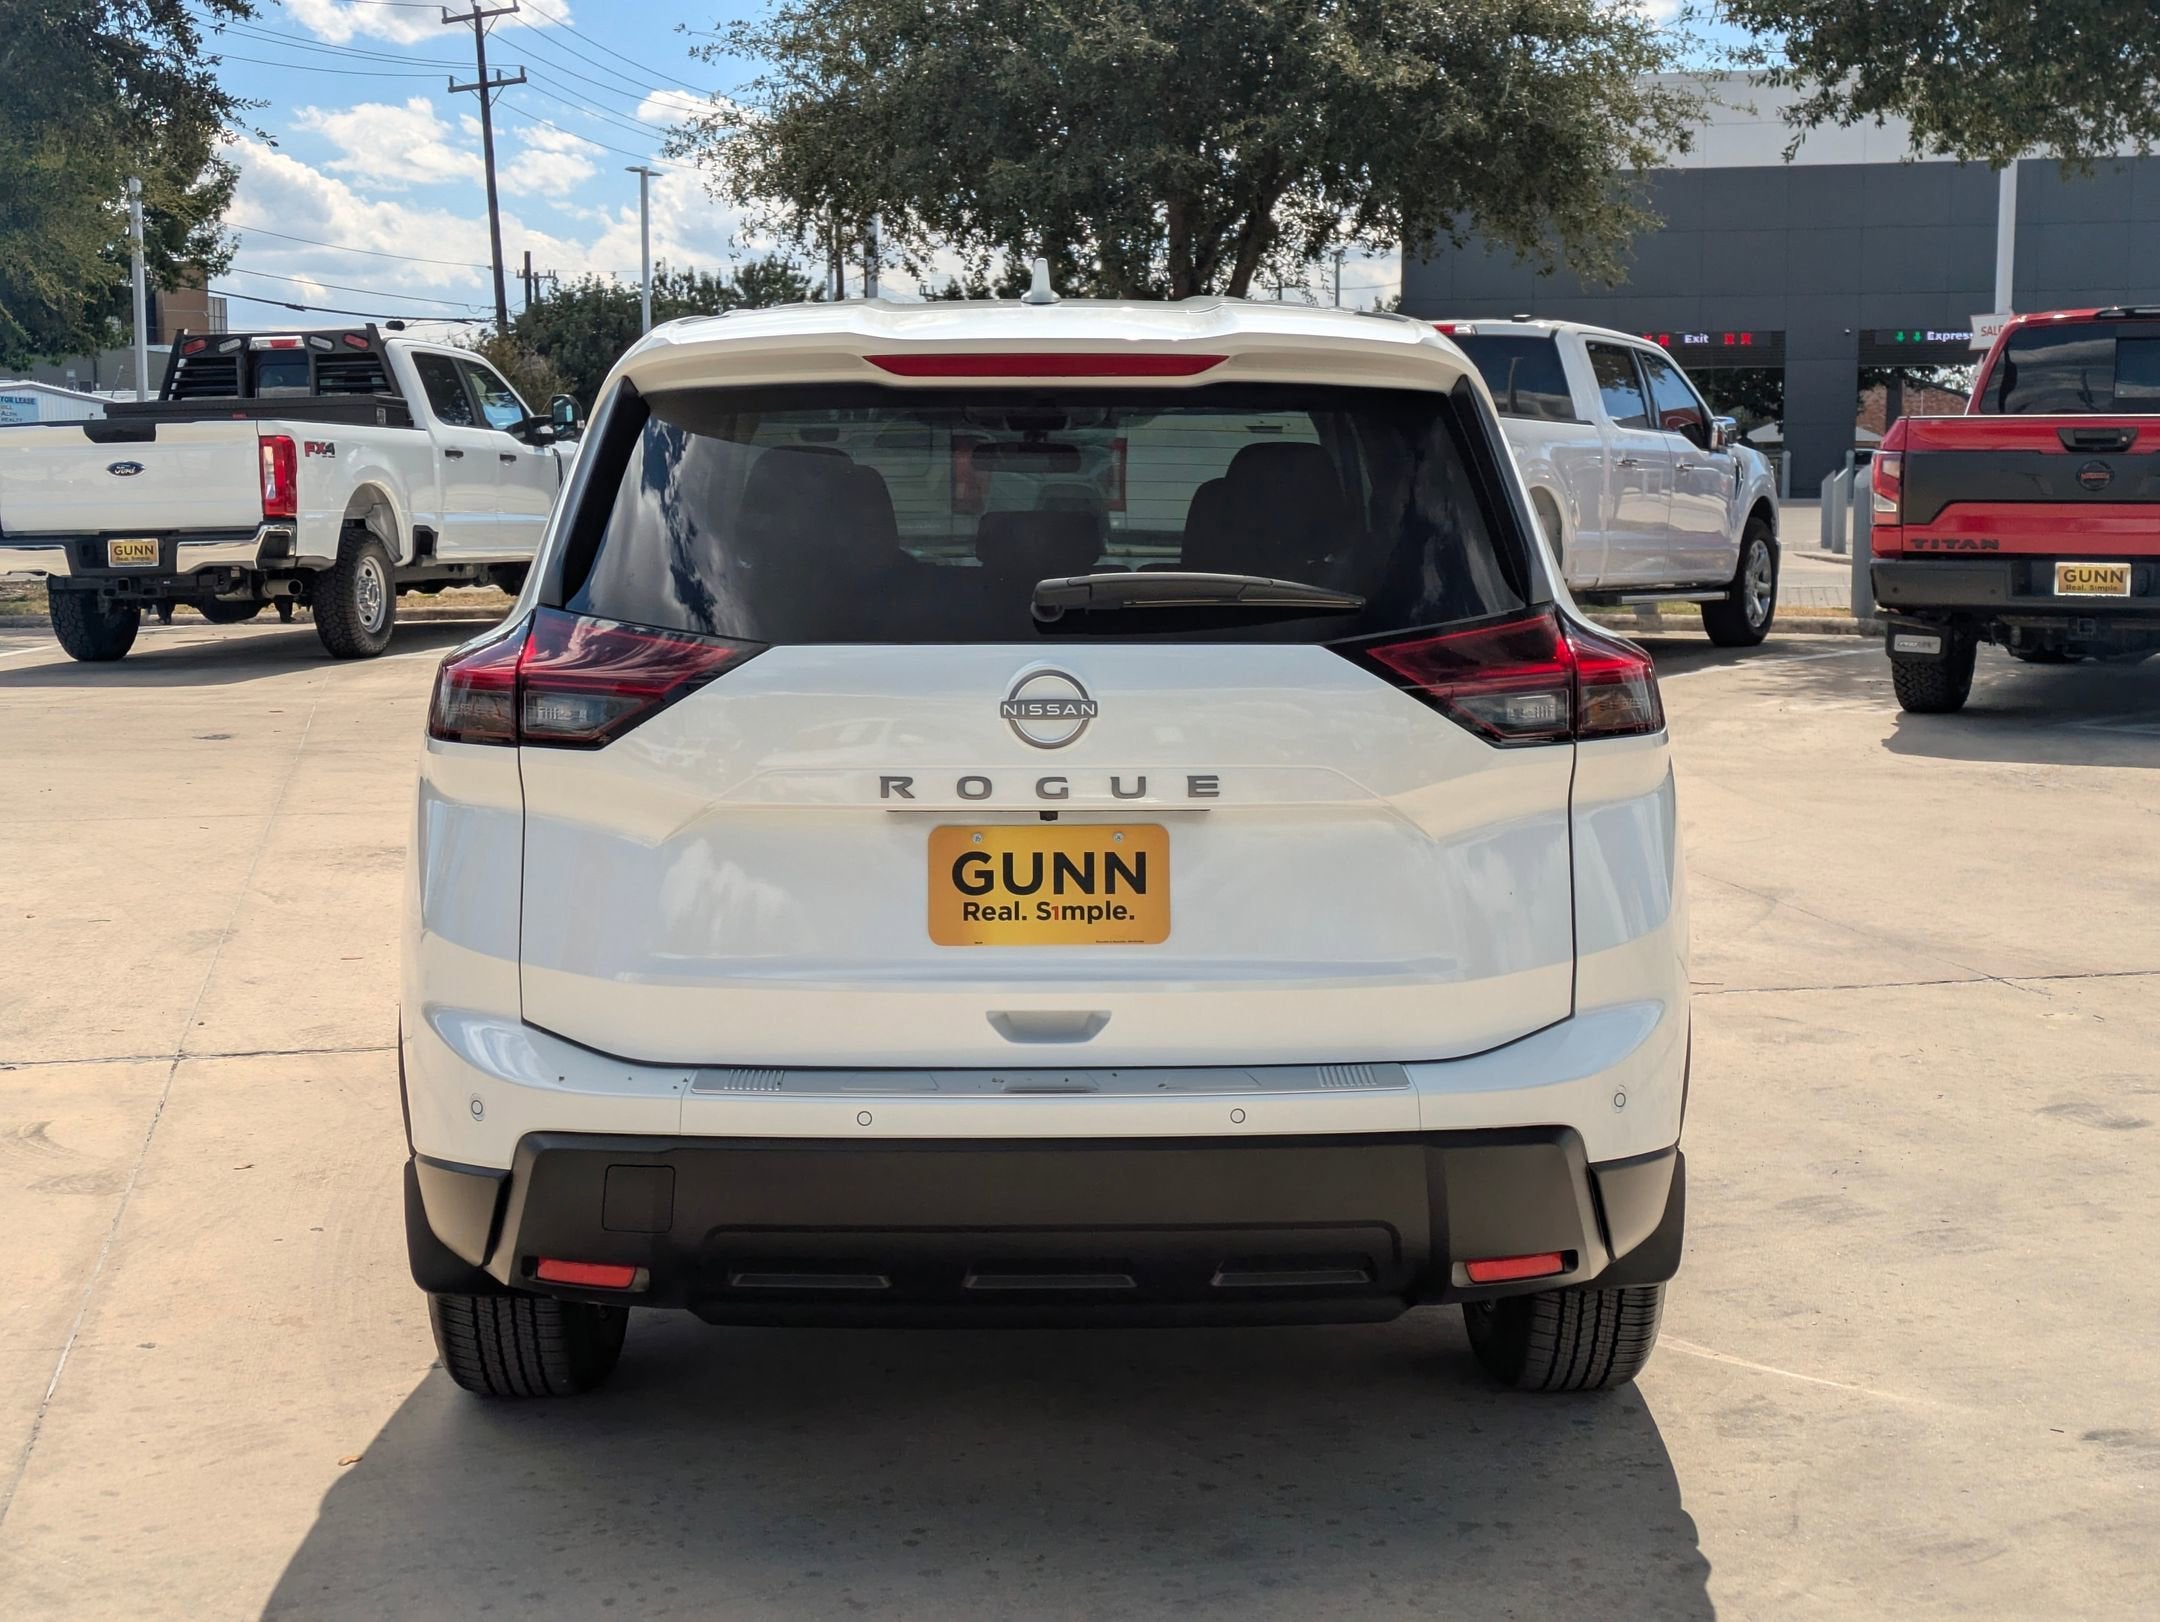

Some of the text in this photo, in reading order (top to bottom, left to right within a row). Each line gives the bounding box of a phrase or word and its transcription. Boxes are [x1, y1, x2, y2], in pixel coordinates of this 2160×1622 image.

[1684, 333, 1709, 344] Exit
[304, 441, 335, 457] FX4
[113, 545, 154, 555] GUNN
[1911, 538, 1999, 550] TITAN
[2063, 569, 2124, 583] GUNN
[1003, 703, 1095, 716] NISSAN
[879, 774, 1221, 801] ROGUE
[951, 850, 1147, 896] GUNN
[962, 901, 1028, 922] Real.
